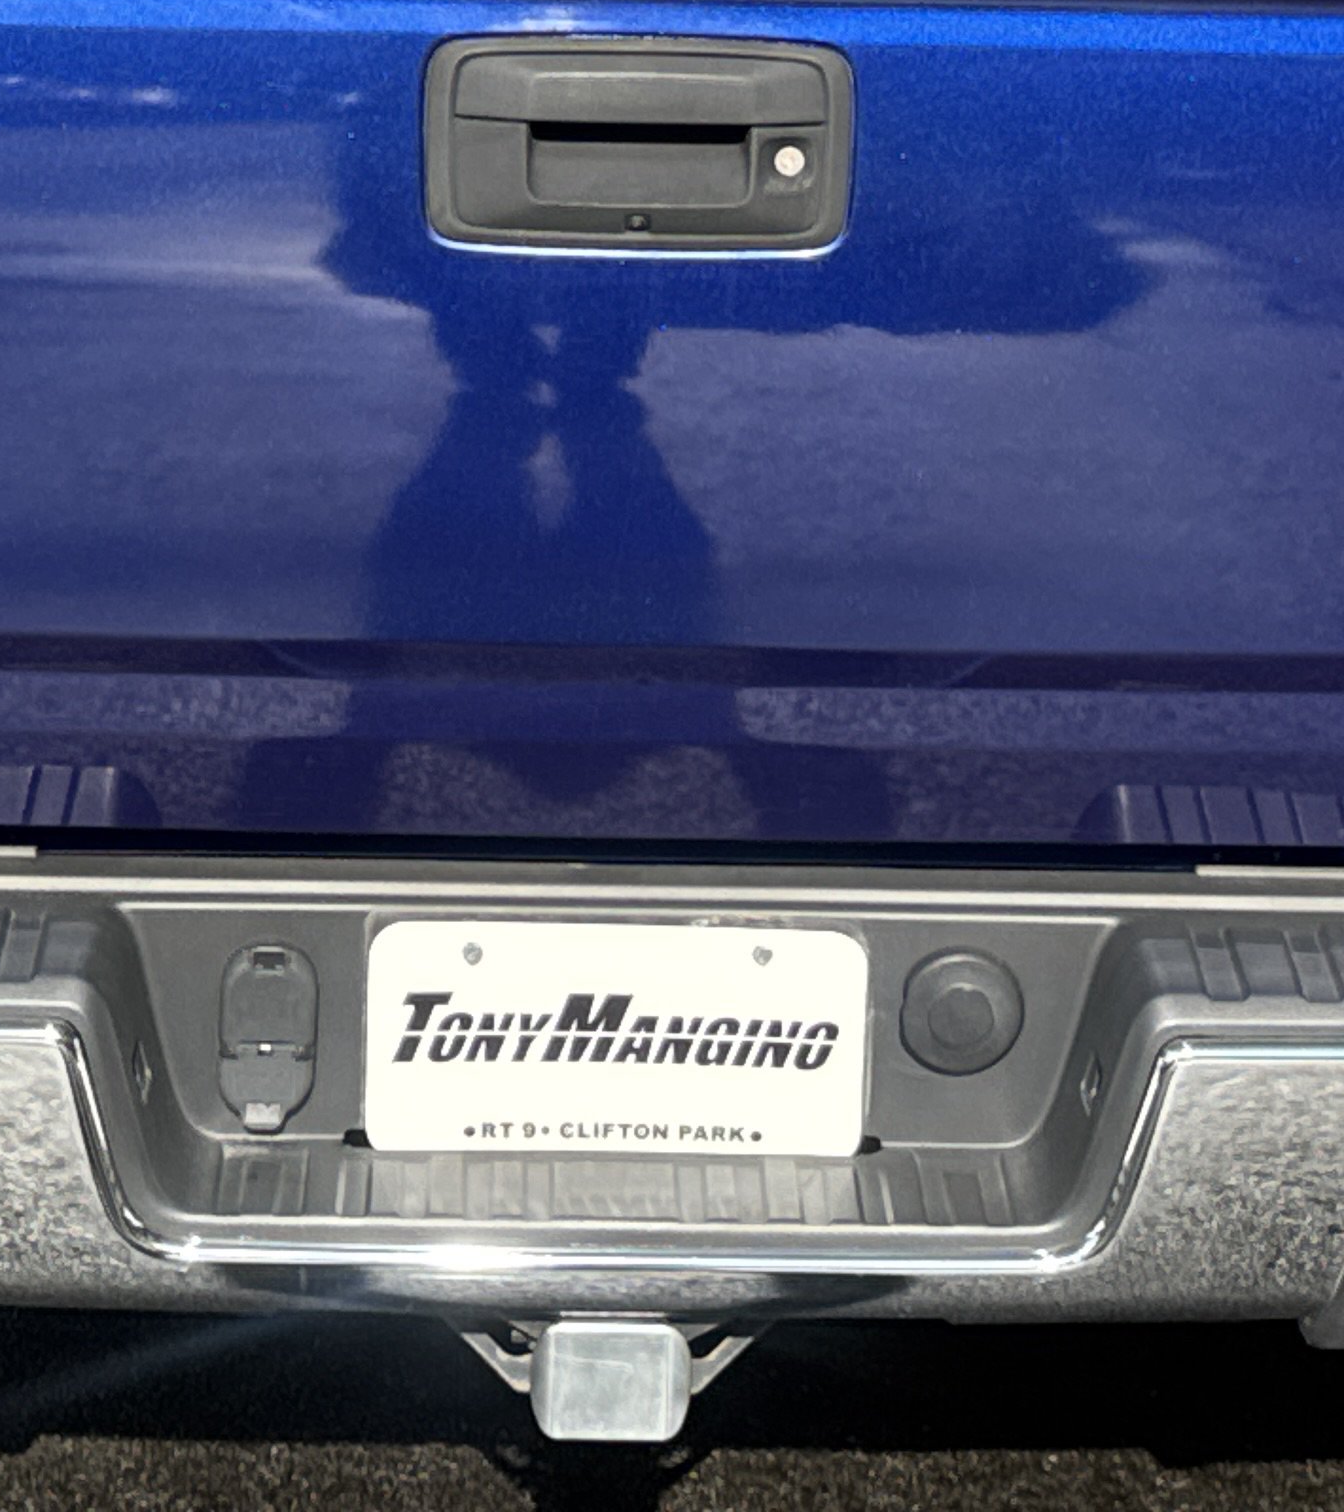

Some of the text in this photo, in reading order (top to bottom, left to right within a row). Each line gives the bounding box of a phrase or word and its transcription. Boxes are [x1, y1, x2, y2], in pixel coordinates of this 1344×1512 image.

[522, 1122, 537, 1139] 9
[559, 1122, 669, 1141] CLIFTON
[678, 1124, 746, 1143] PARK
